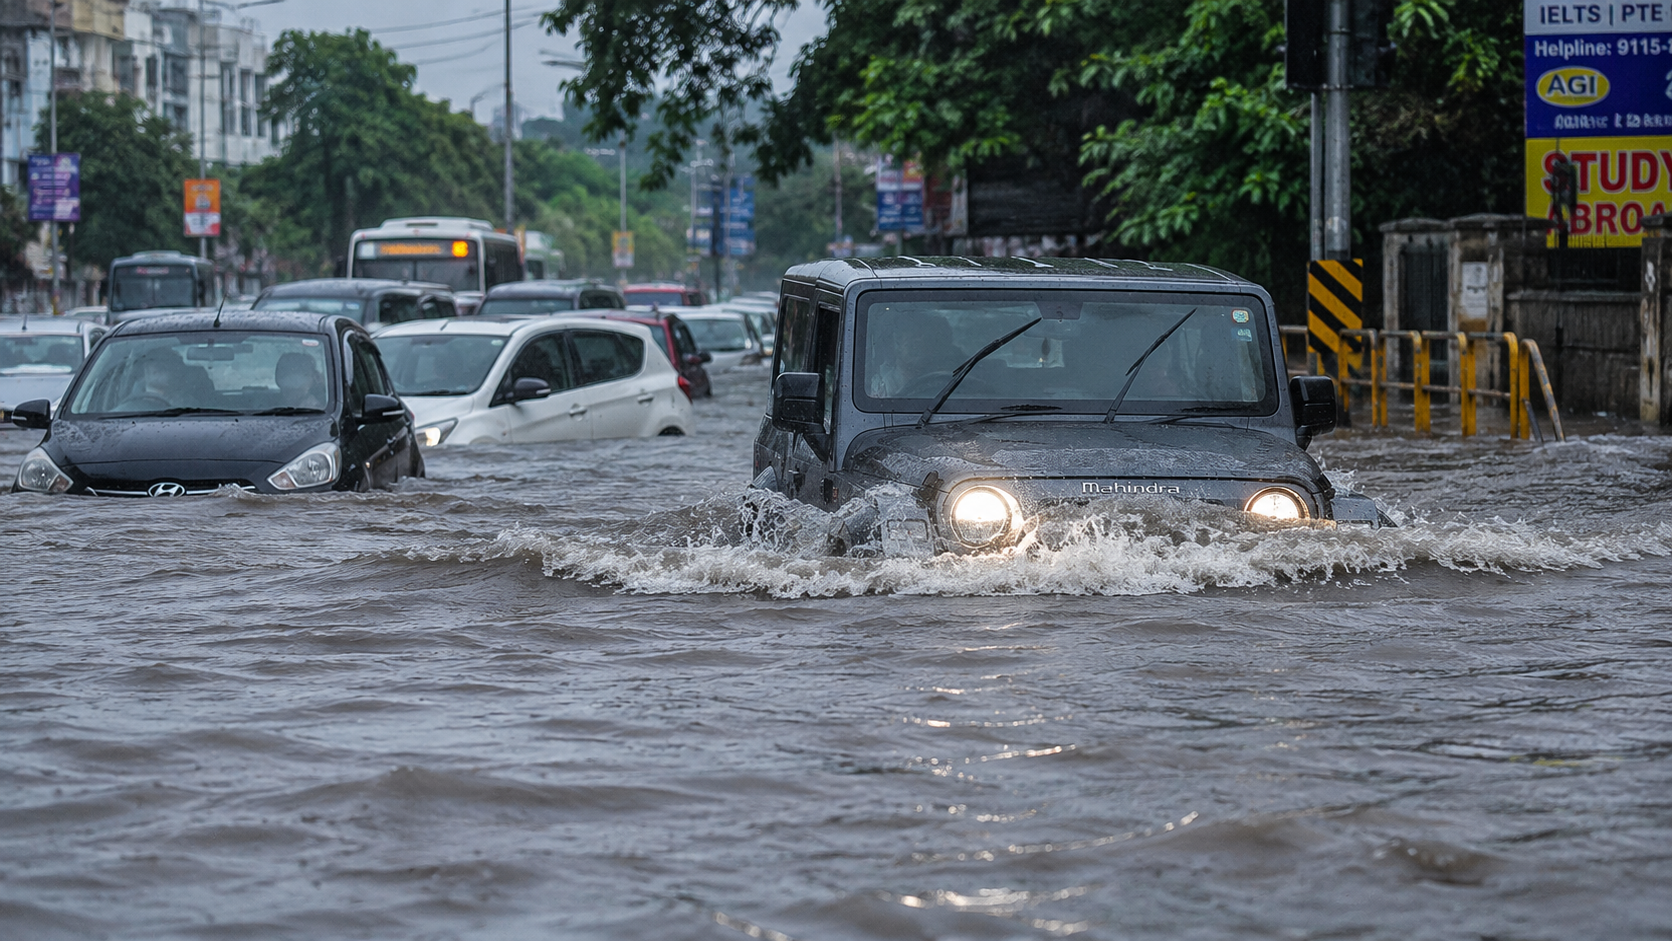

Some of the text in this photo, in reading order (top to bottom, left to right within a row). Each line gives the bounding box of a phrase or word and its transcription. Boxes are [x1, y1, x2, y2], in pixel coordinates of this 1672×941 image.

[1540, 4, 1601, 25] IELTS
[1621, 3, 1664, 23] PTE
[1534, 39, 1612, 60] Helpline:
[1546, 74, 1599, 98] AGI
[1081, 481, 1181, 495] Mahindra
